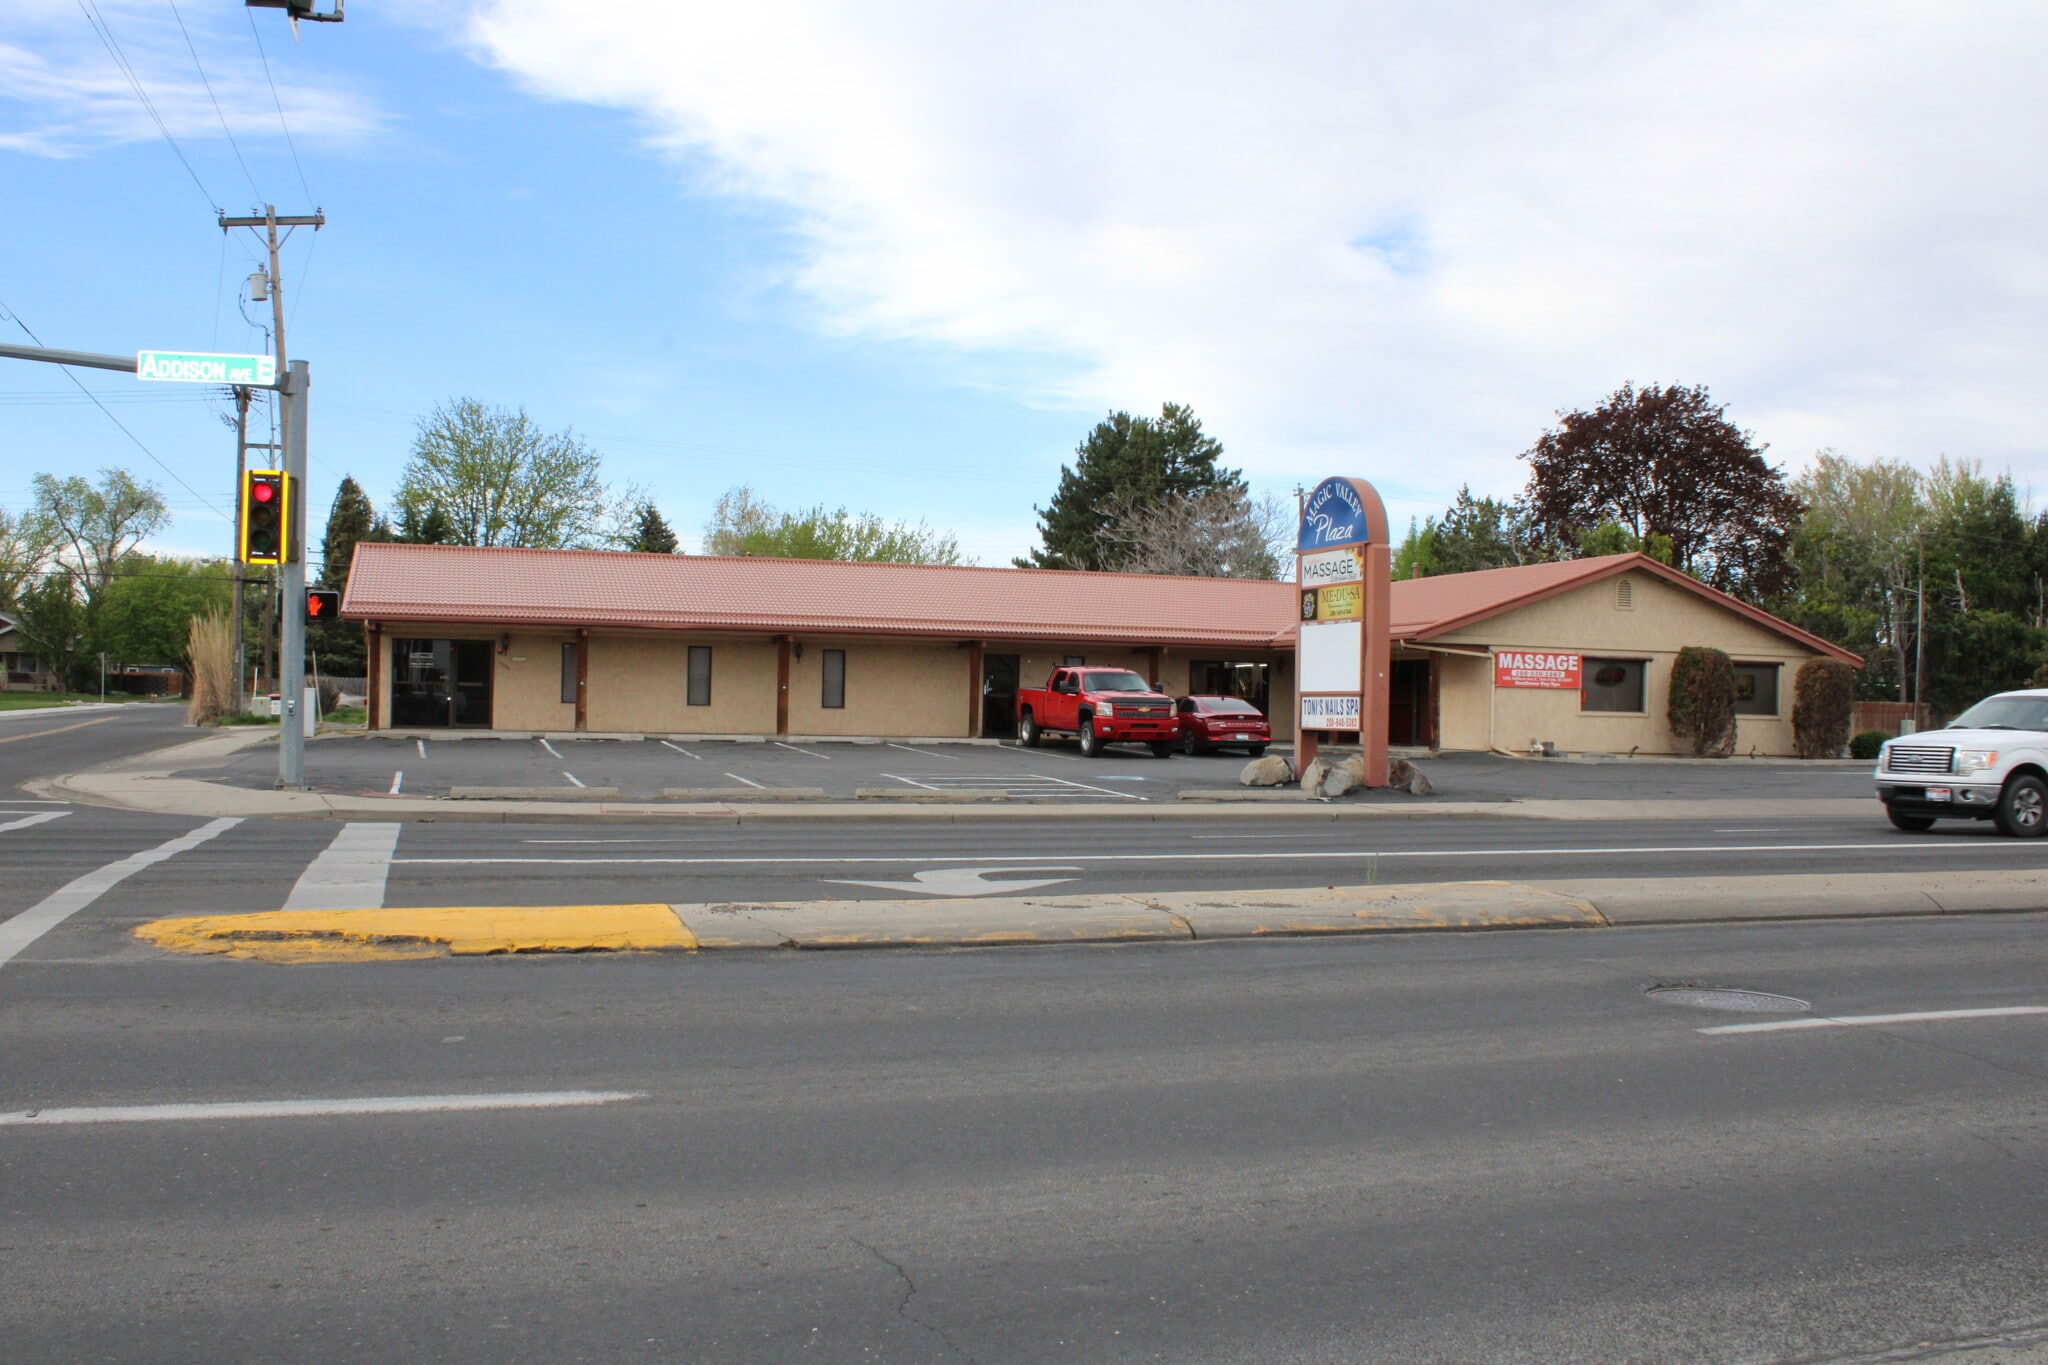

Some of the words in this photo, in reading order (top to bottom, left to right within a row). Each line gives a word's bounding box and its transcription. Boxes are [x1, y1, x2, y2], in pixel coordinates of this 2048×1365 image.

[141, 354, 226, 380] ADDISON
[228, 368, 253, 381] AVE
[257, 357, 273, 381] E
[1306, 485, 1333, 527] MAGIC
[1335, 483, 1362, 518] VALLEY
[1313, 514, 1353, 545] Plaza
[1304, 559, 1353, 579] MASSAGE
[1499, 652, 1578, 671] MASSAGE
[1304, 699, 1323, 715] TONI'S
[1325, 699, 1344, 715] NAILS
[1345, 699, 1359, 715] SPA
